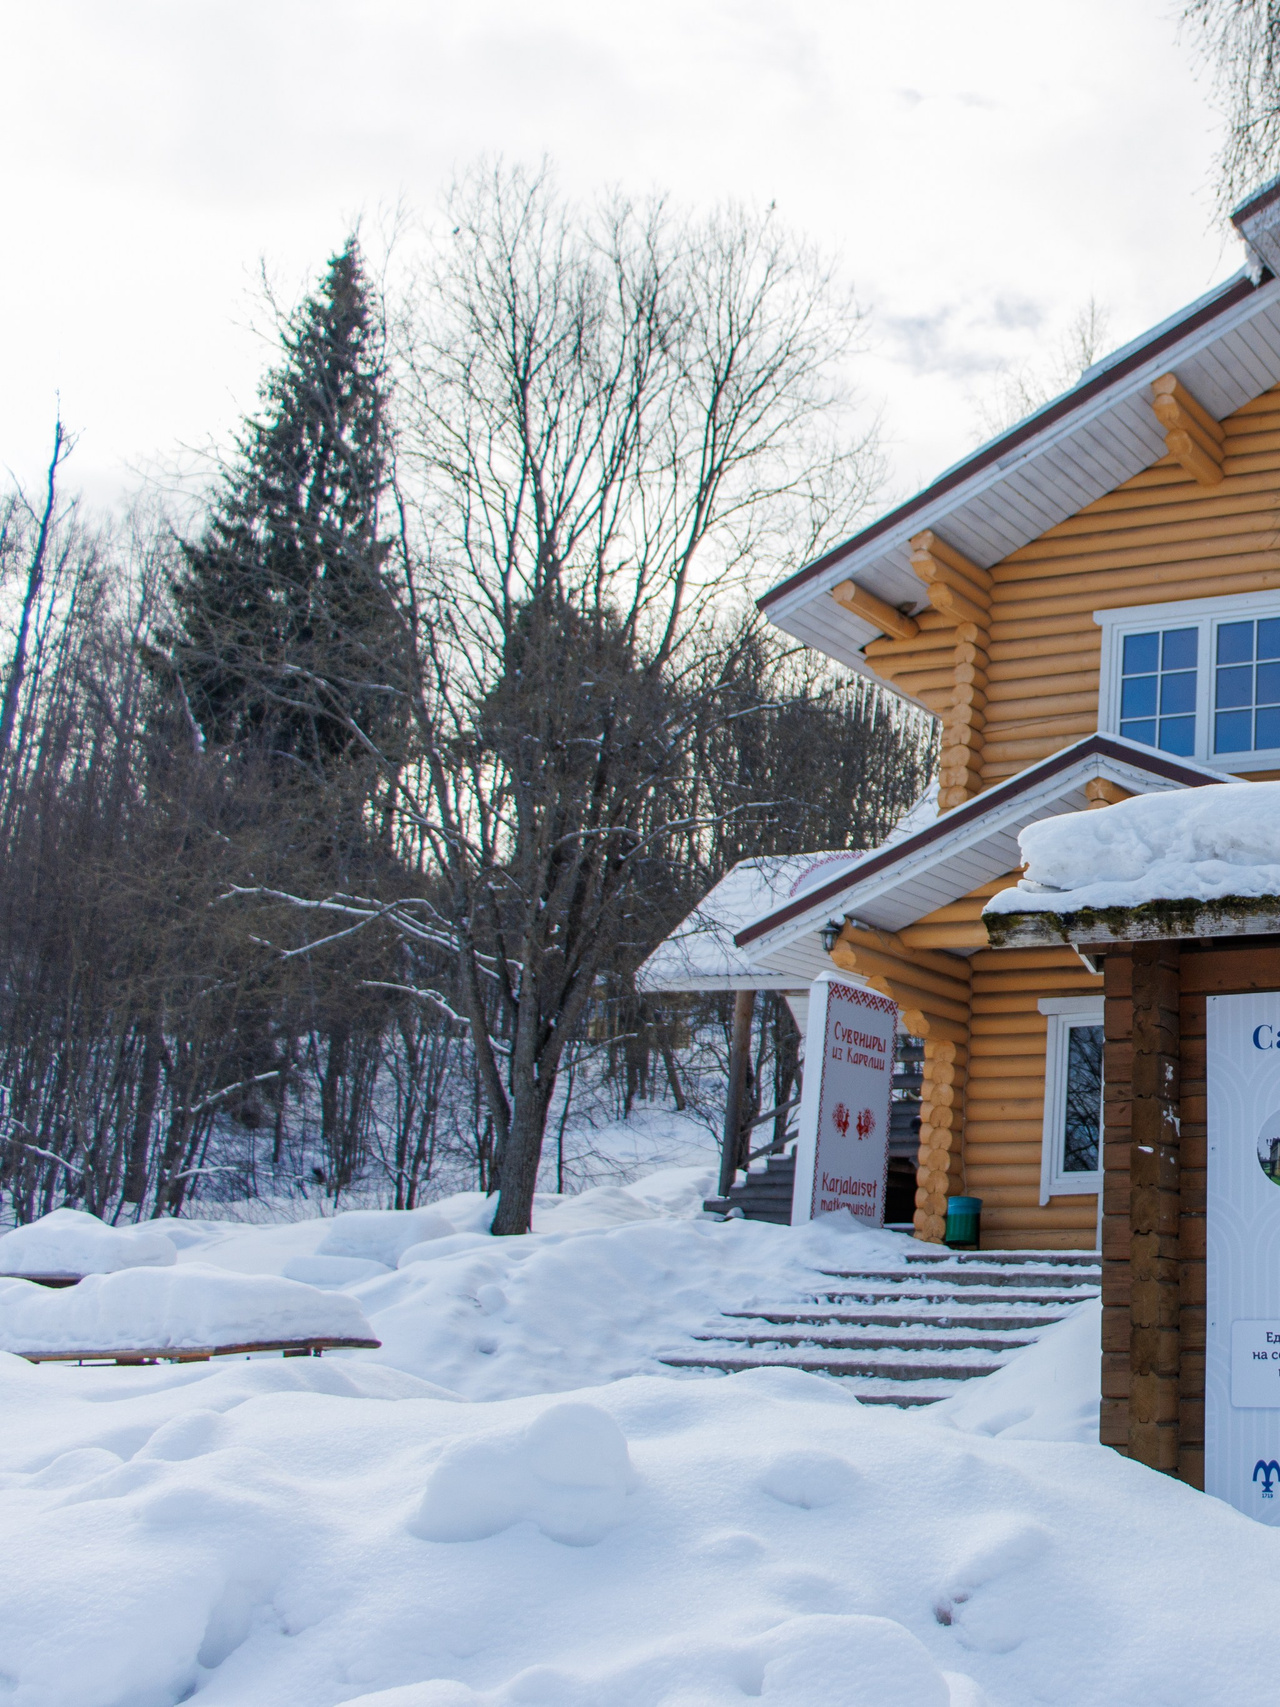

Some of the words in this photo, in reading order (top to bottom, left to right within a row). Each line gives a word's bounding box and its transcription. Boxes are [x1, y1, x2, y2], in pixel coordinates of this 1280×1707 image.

[834, 1021, 887, 1053] Сувениры
[832, 1046, 843, 1060] из
[847, 1047, 885, 1071] Карелии
[821, 1171, 877, 1198] Karjalaiset
[1252, 1351, 1268, 1360] на
